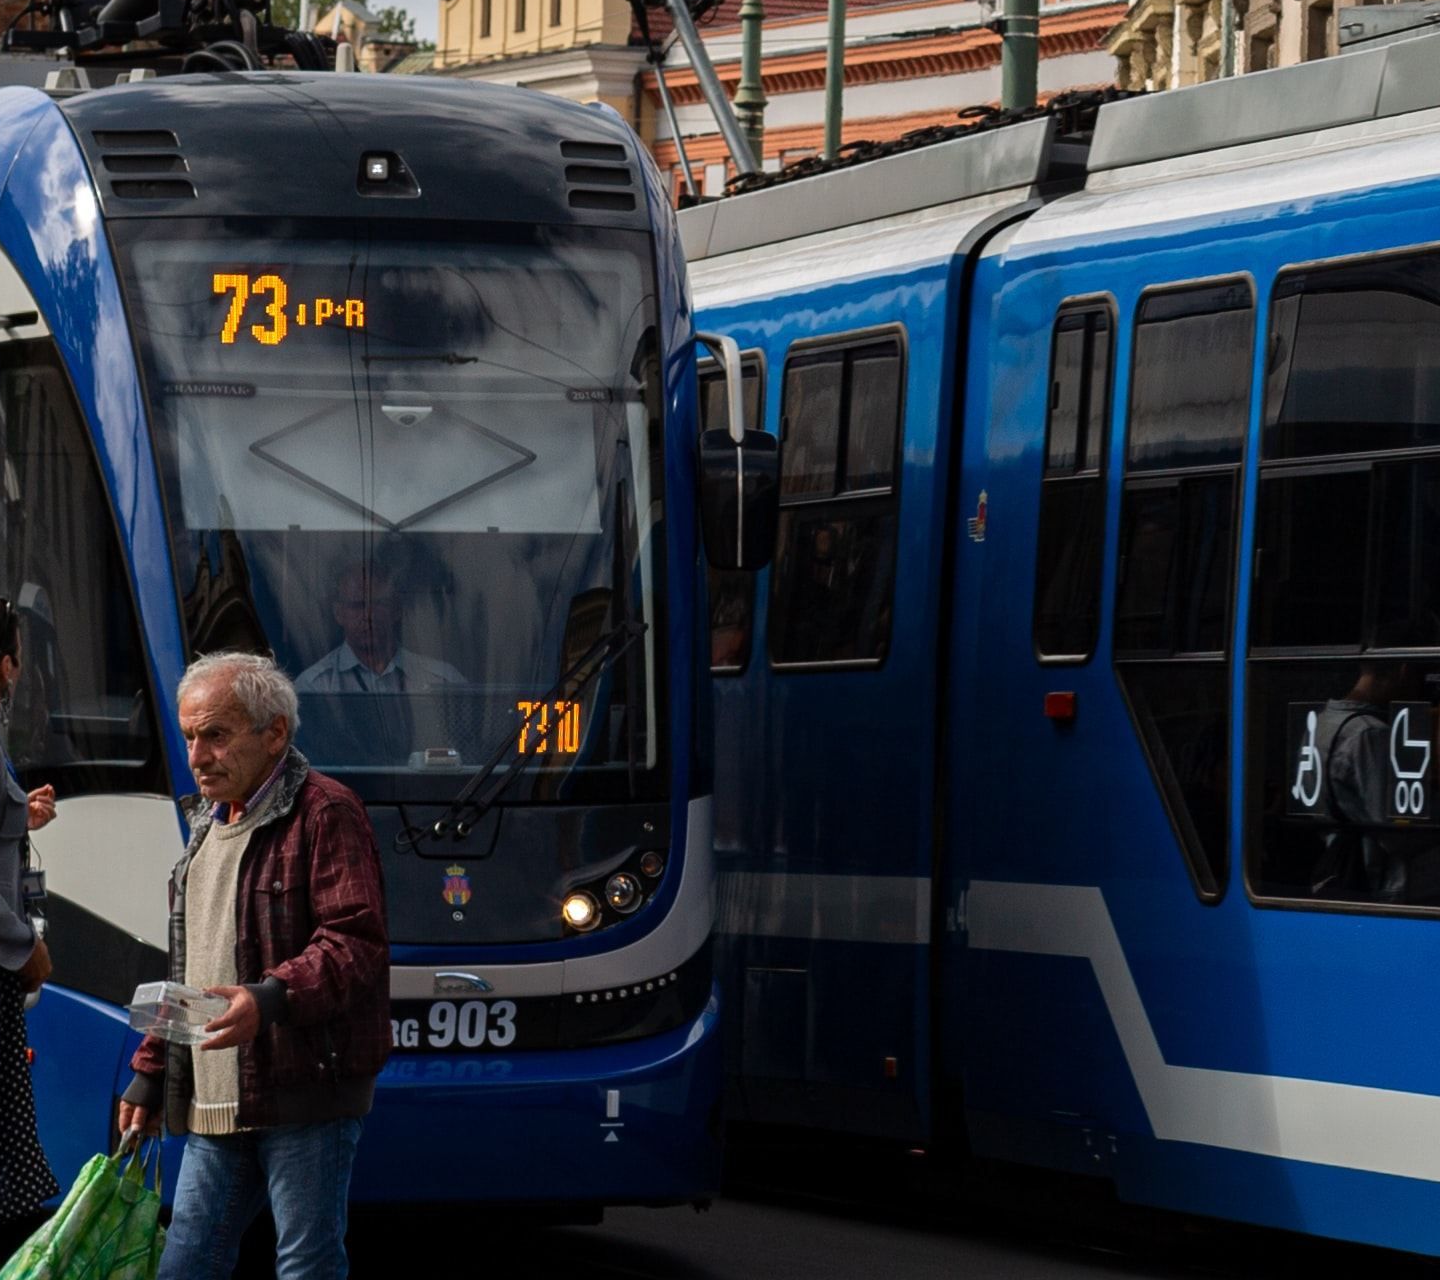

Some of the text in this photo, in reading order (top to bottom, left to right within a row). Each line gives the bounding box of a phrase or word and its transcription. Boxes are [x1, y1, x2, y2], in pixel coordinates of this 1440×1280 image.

[213, 274, 287, 344] 73
[315, 298, 364, 327] P+R
[428, 1000, 517, 1048] 903
